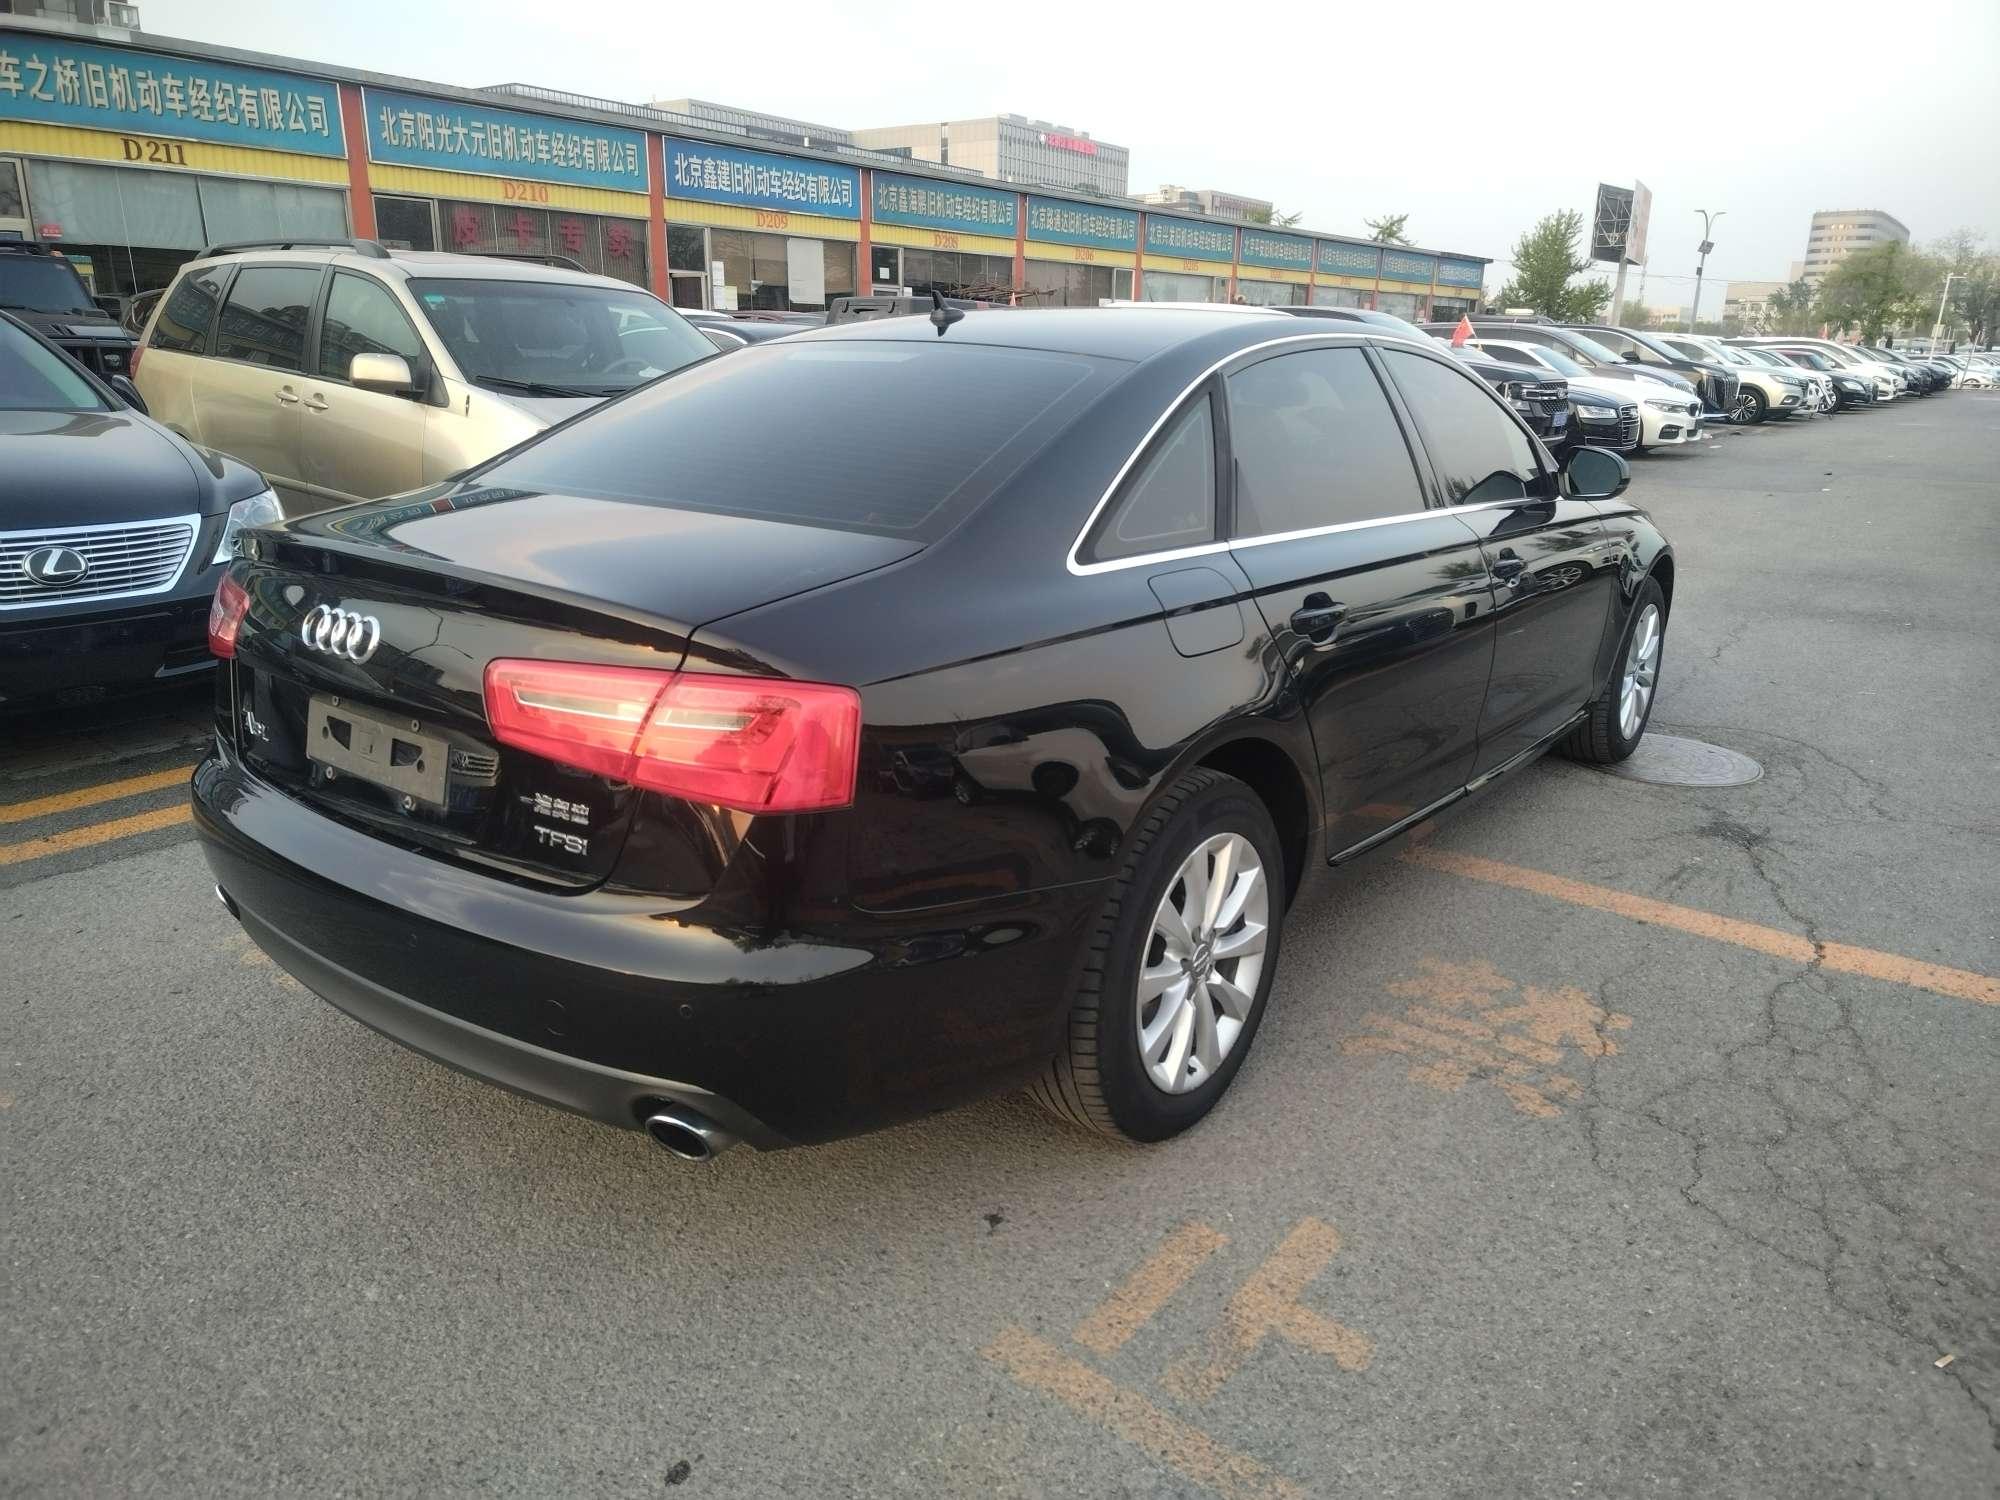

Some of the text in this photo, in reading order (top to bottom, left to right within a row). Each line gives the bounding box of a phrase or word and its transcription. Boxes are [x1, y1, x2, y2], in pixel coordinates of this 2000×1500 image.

[0, 50, 330, 138] 车之桥旧机动车经纪有限公司
[121, 137, 188, 166] D211
[379, 105, 640, 177] 北京阳光大元旧机动车经纪有限公司
[503, 182, 549, 204] D210
[674, 152, 853, 208] 北京鑫建旧机动车经纪有限公司
[756, 212, 789, 229] D209
[533, 824, 589, 857] TFSI
